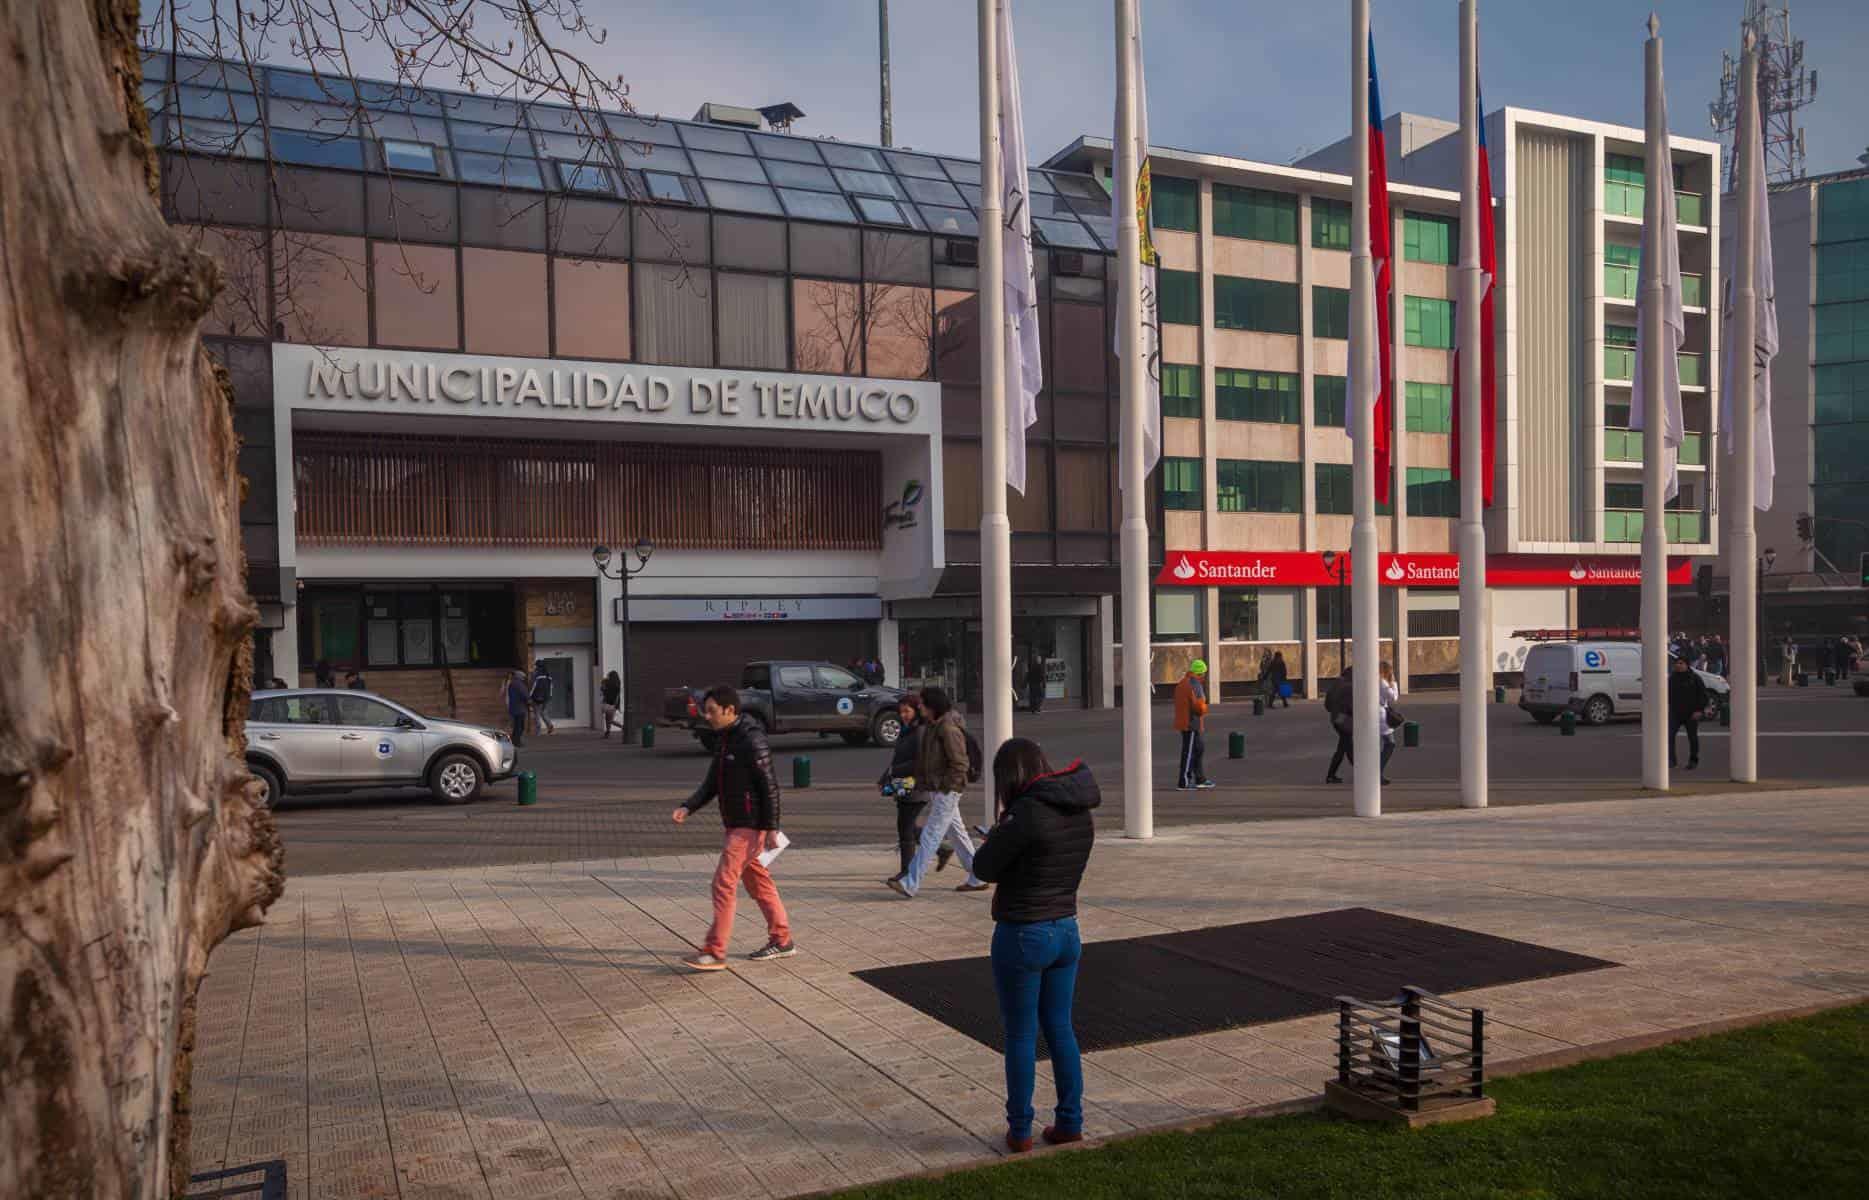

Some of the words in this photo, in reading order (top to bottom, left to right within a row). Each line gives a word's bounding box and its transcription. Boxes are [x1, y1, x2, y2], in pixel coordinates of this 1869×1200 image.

[307, 358, 673, 412] MUNICIPALIDAD
[689, 375, 740, 415] DE
[754, 379, 919, 424] TEMUCO
[1199, 560, 1277, 578] Santander
[1408, 562, 1460, 579] Santand
[1588, 563, 1642, 579] Santande
[705, 599, 802, 612] RIPLEY
